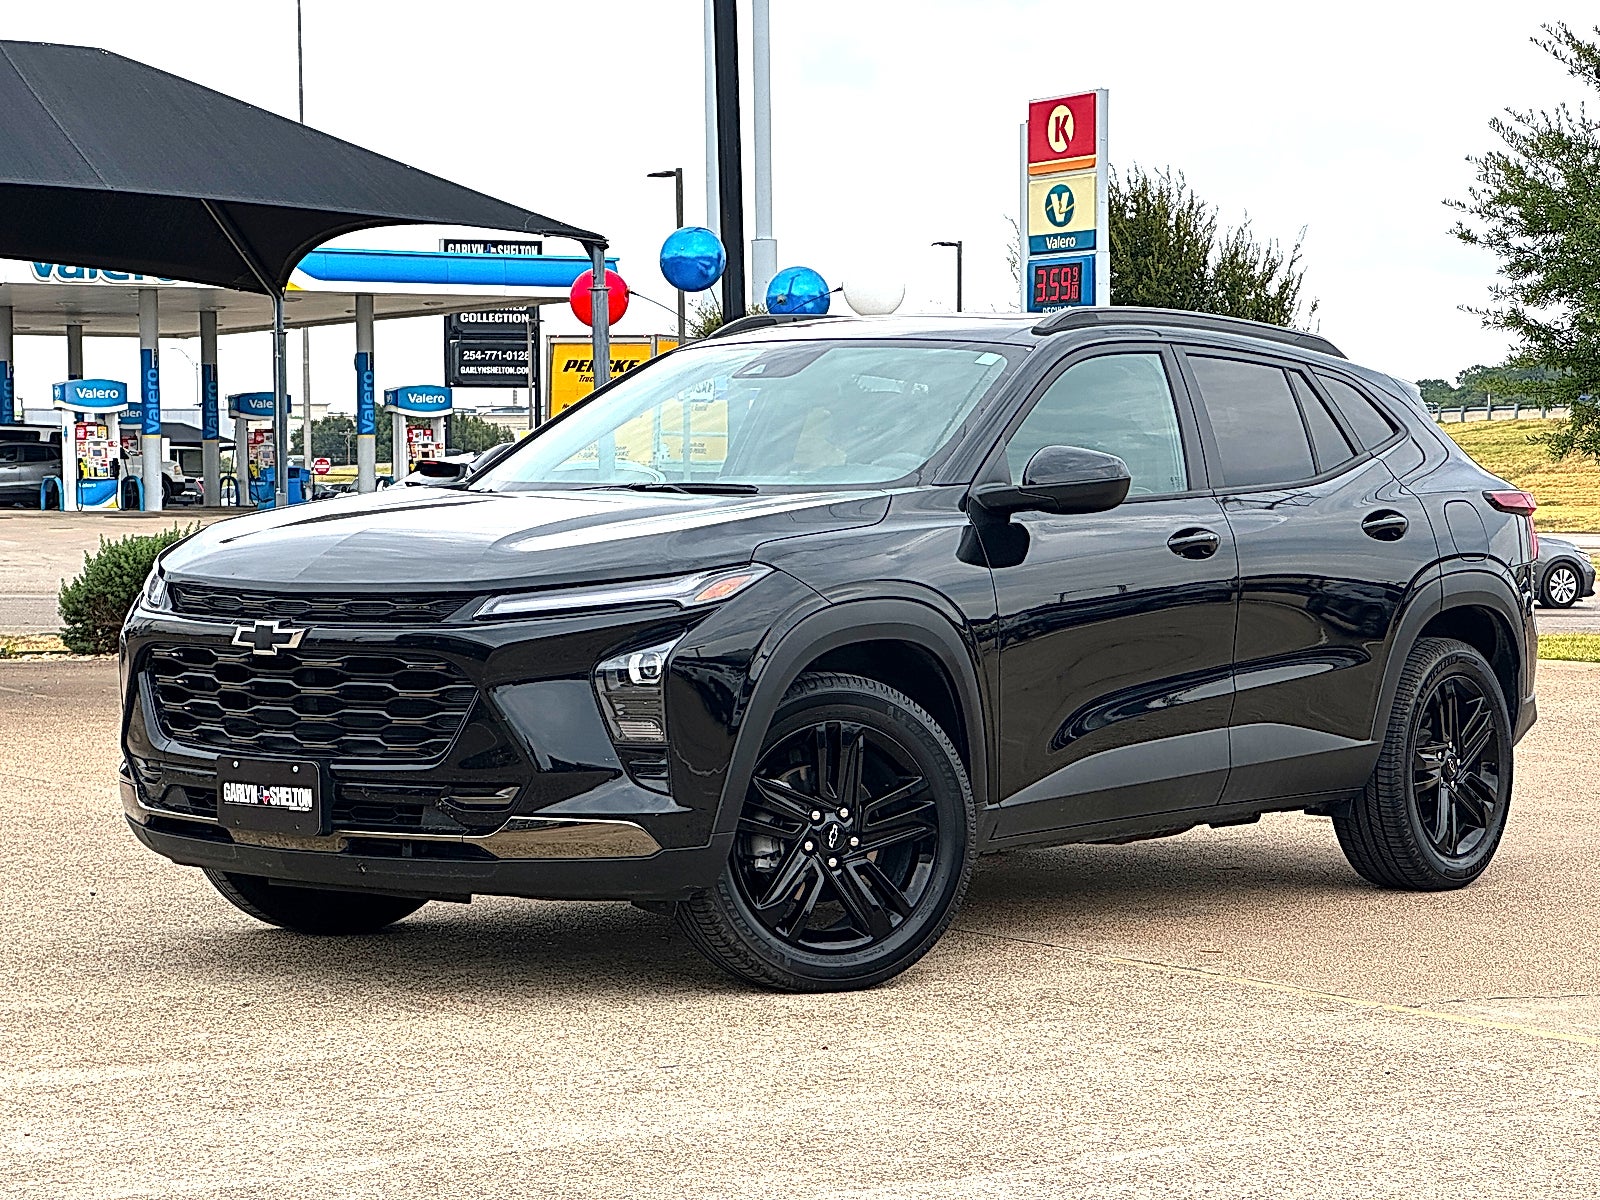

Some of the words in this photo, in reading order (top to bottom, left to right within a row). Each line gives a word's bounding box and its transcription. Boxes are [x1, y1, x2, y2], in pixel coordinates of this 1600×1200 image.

[1054, 114, 1072, 147] K
[1045, 235, 1076, 250] Valero
[1036, 267, 1071, 302] 3.59
[460, 312, 530, 323] COLLECTION
[463, 350, 529, 361] 254-771-0128
[562, 359, 641, 373] PEKE
[578, 374, 594, 383] Truc
[75, 387, 119, 399] Valero
[407, 392, 446, 404] Valero
[146, 368, 160, 434] Valero
[249, 399, 274, 409] Vale
[361, 370, 375, 434] Valero
[206, 381, 218, 439] Valero
[223, 782, 259, 804] GARLYN
[269, 786, 313, 808] SHELTON
